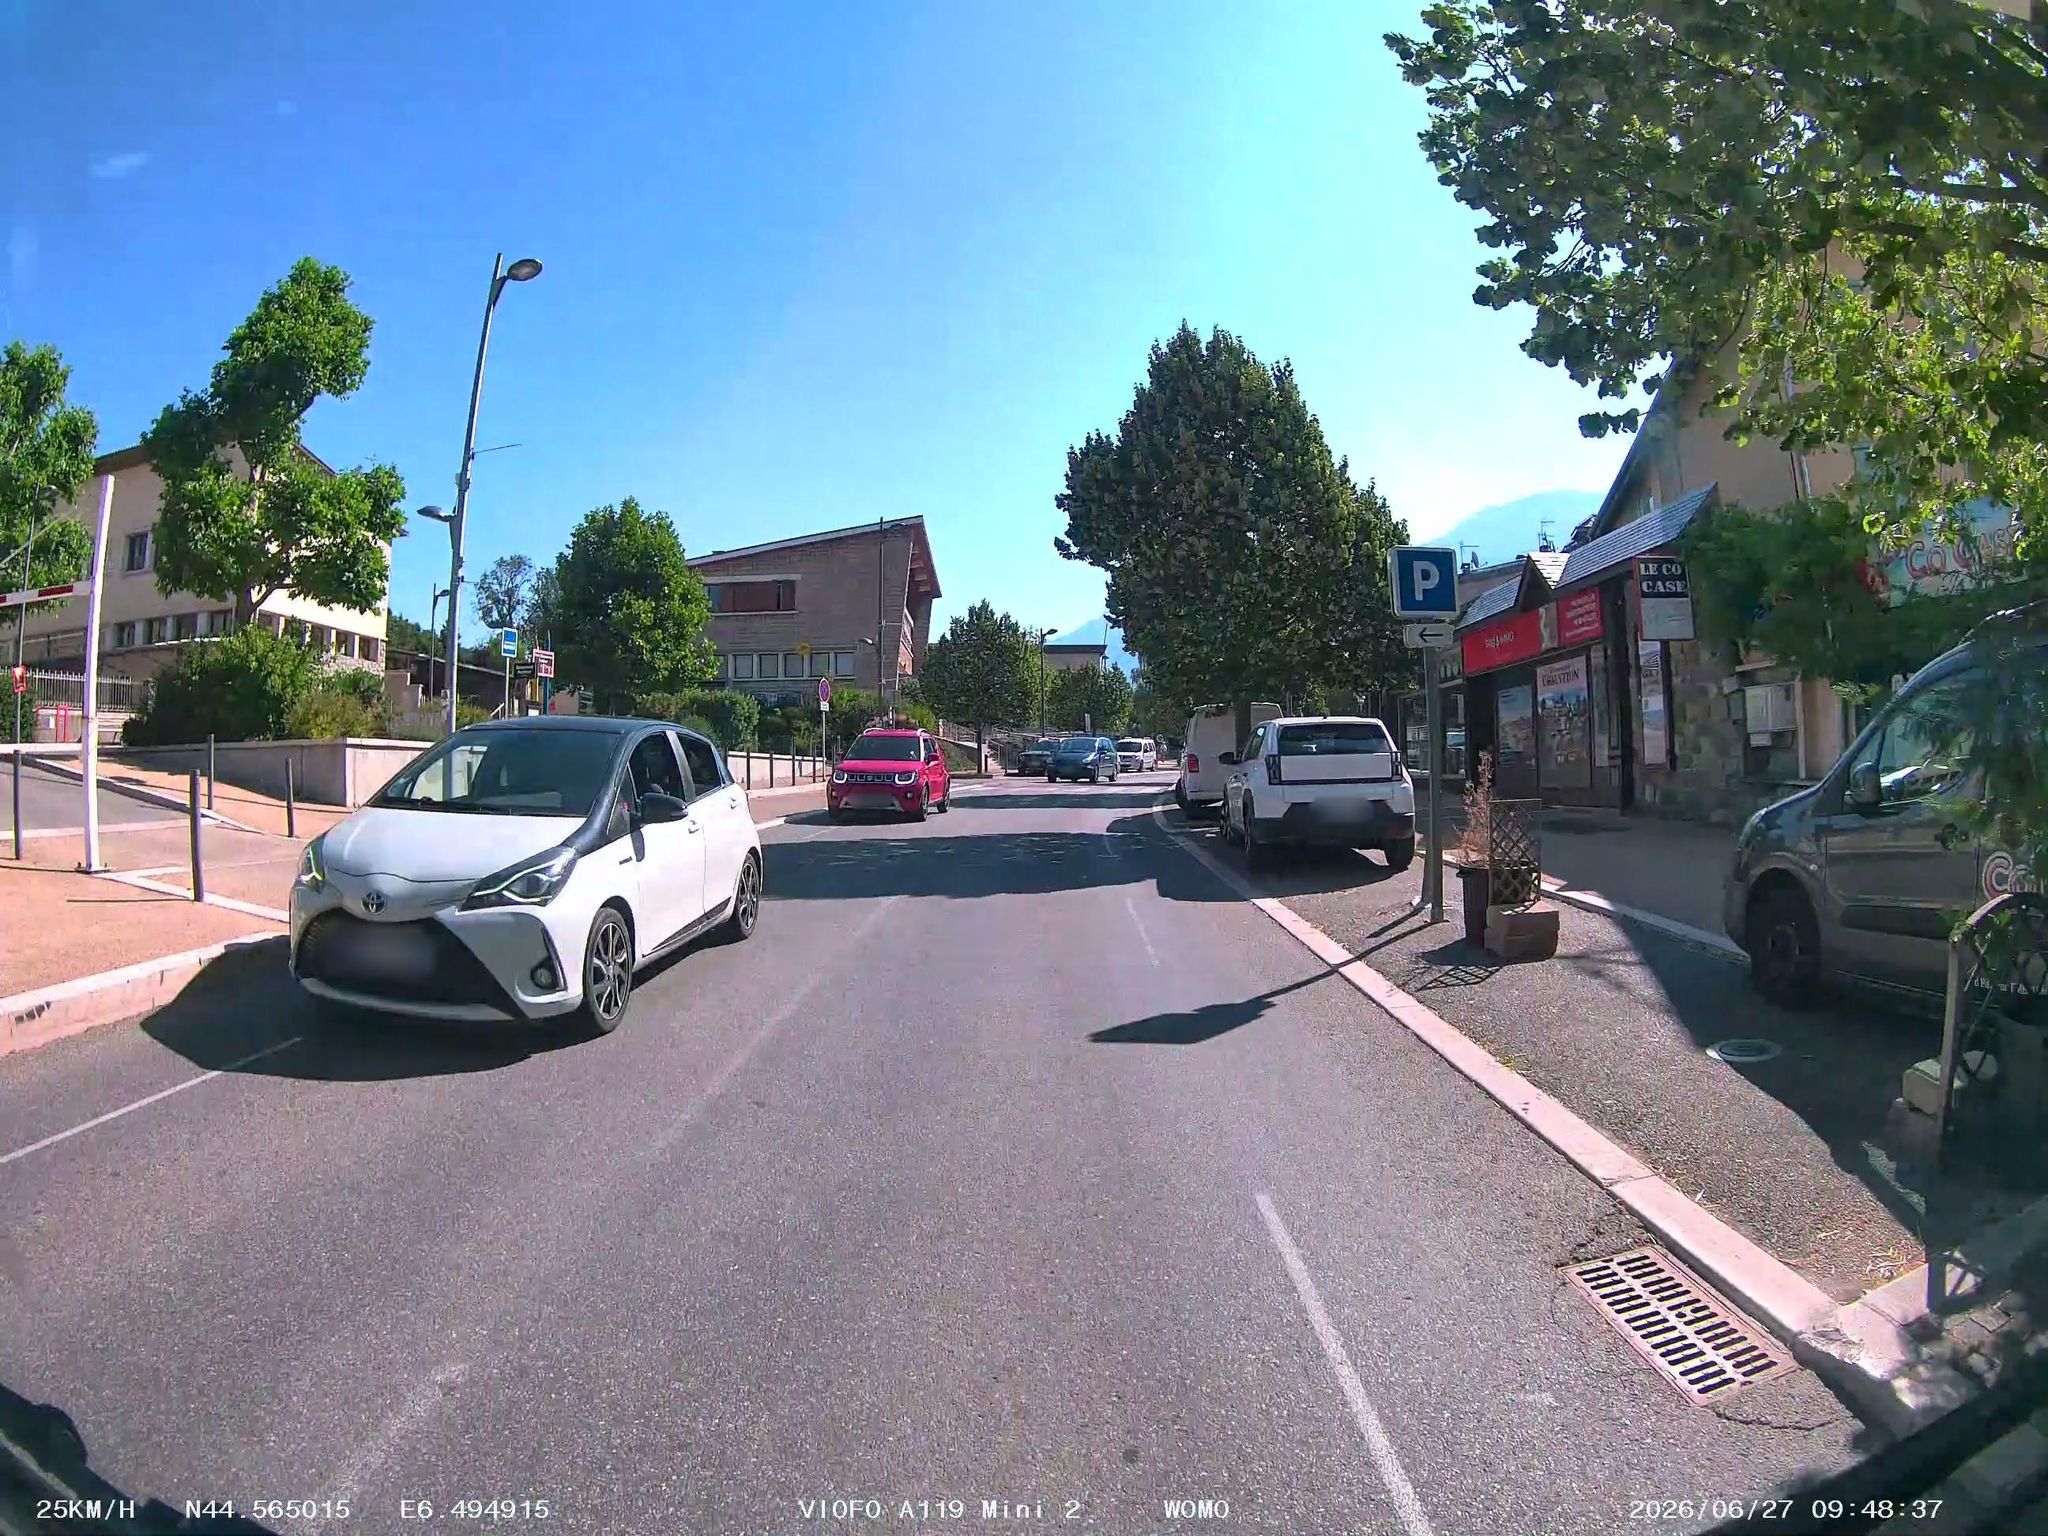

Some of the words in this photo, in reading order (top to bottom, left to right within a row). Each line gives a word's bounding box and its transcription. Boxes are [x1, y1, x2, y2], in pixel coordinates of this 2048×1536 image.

[1412, 560, 1440, 601] P
[1640, 563, 1659, 575] LE
[1661, 563, 1682, 575] CO
